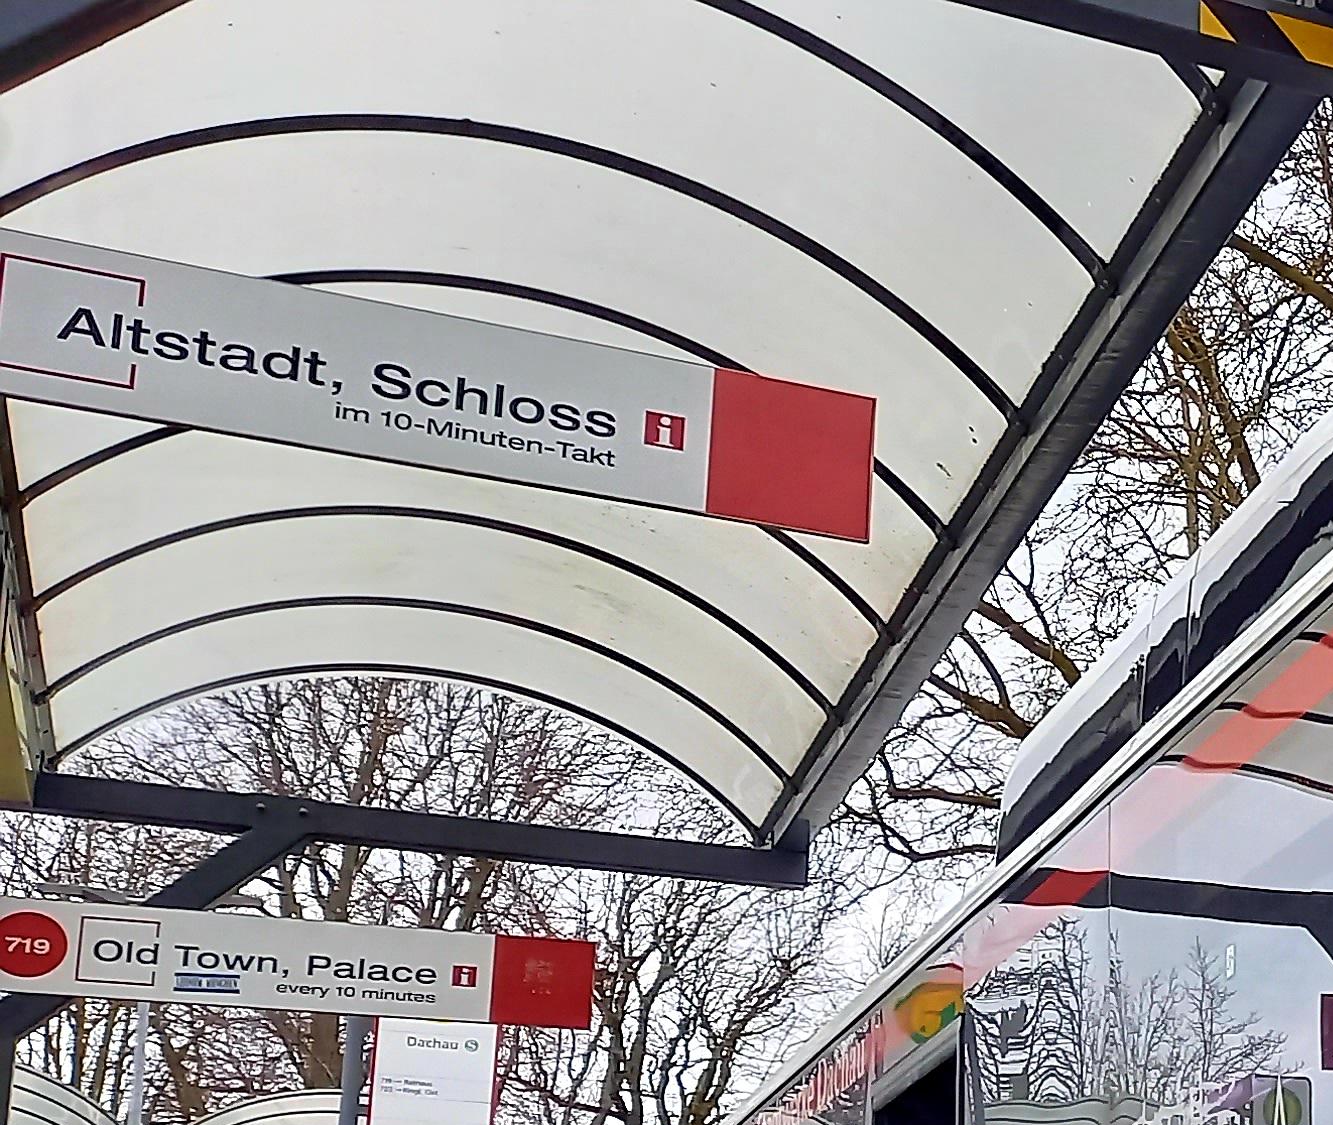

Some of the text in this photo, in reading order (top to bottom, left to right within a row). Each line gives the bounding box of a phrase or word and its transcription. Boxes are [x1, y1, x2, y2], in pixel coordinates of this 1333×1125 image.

[57, 307, 344, 396] Altstadt,
[372, 363, 617, 439] Schloss
[334, 402, 617, 468] im 10-Minuten-Takt
[4, 936, 51, 955] 719
[93, 939, 160, 966] Old
[174, 944, 290, 978] Town,
[306, 954, 438, 985] Palace
[275, 982, 437, 1004] every 10 minutes
[406, 1035, 459, 1051] Dachau
